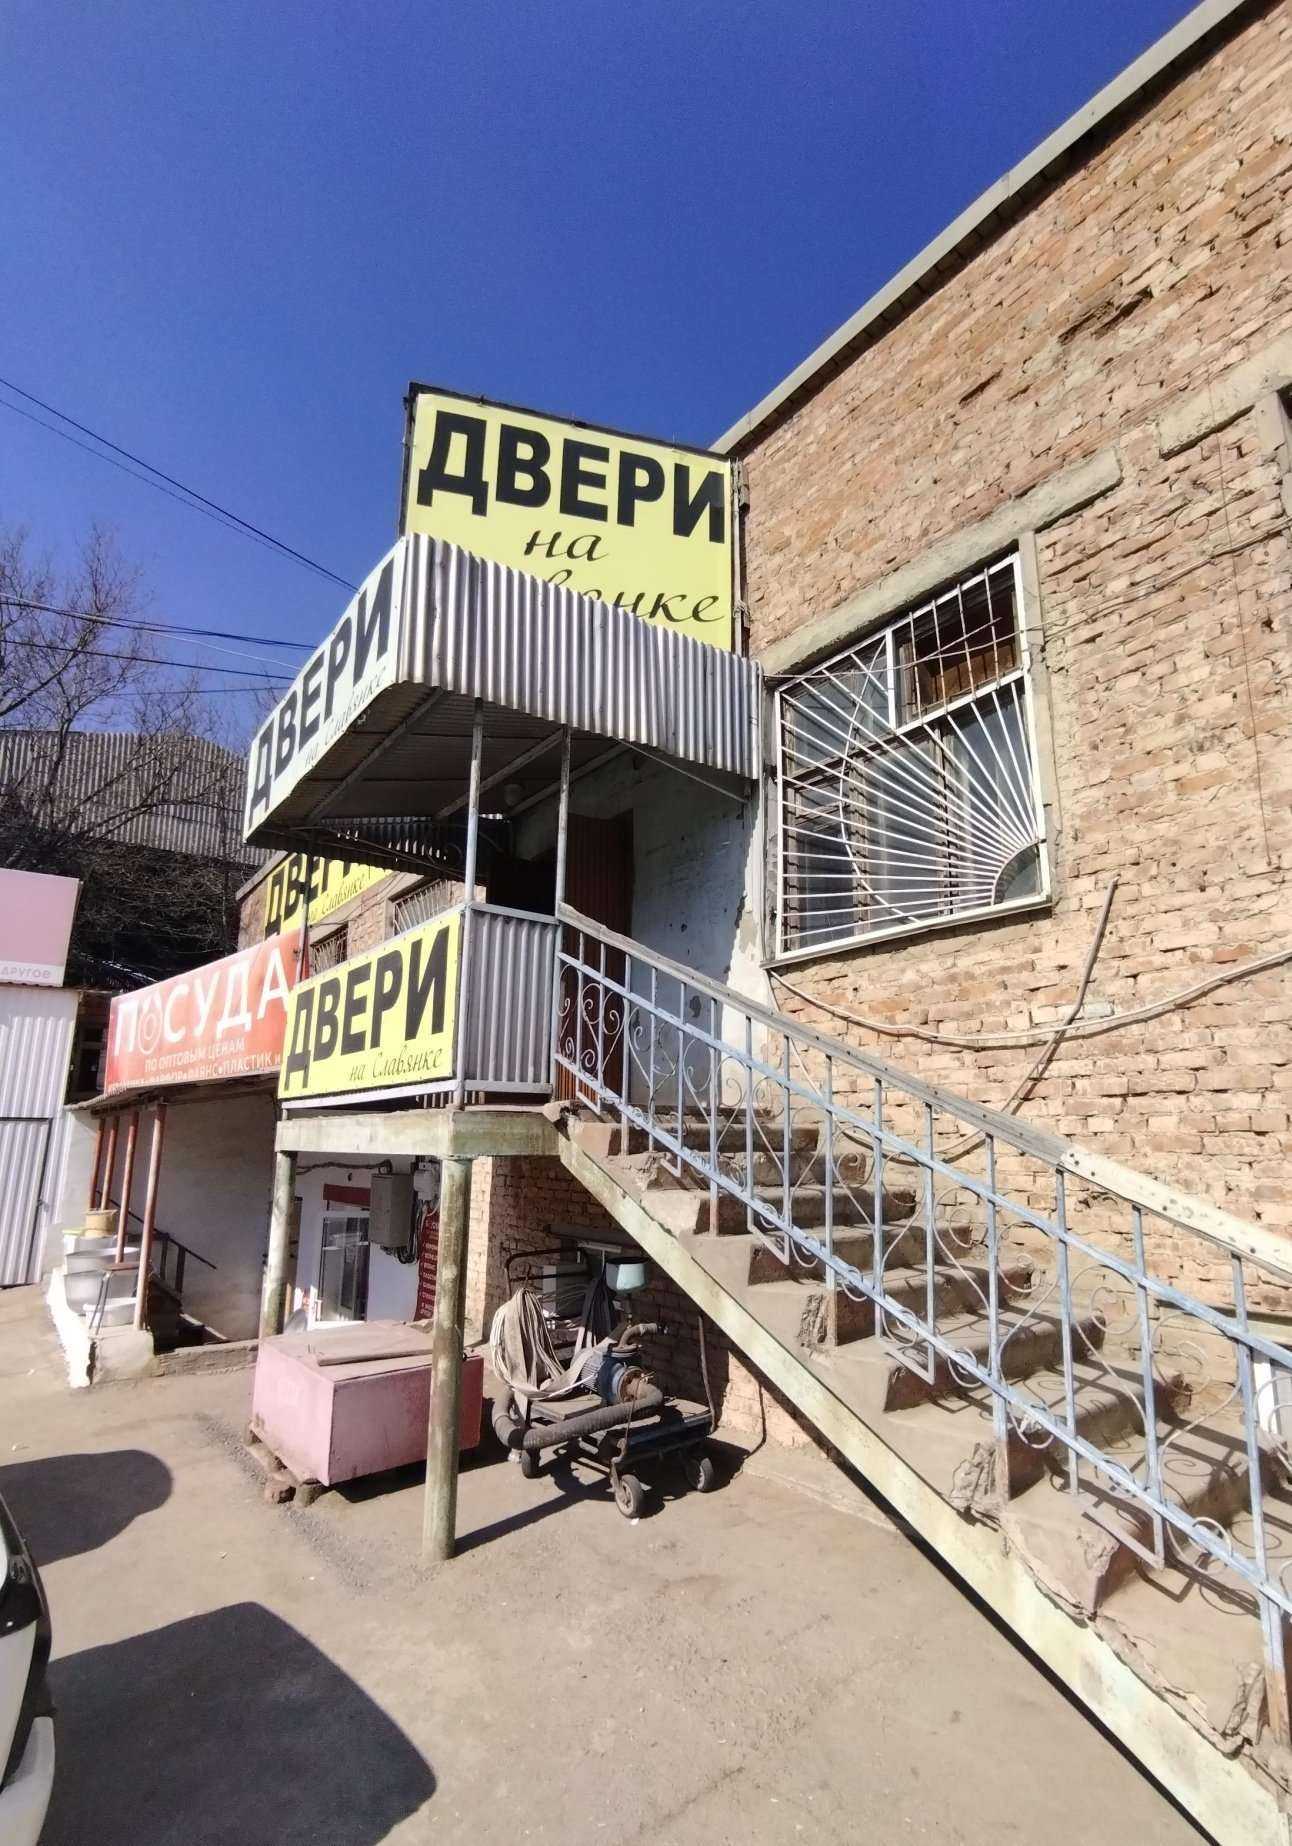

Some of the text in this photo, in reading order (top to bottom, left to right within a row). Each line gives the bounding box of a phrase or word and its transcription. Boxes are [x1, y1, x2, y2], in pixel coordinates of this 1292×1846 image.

[416, 409, 725, 544] ДВЕРИ
[523, 529, 610, 562] на
[250, 557, 395, 830] ДВЕРИ
[114, 947, 289, 1057] ПОСУДА
[284, 926, 451, 1091] ДВЕРИ
[349, 1063, 366, 1081] на
